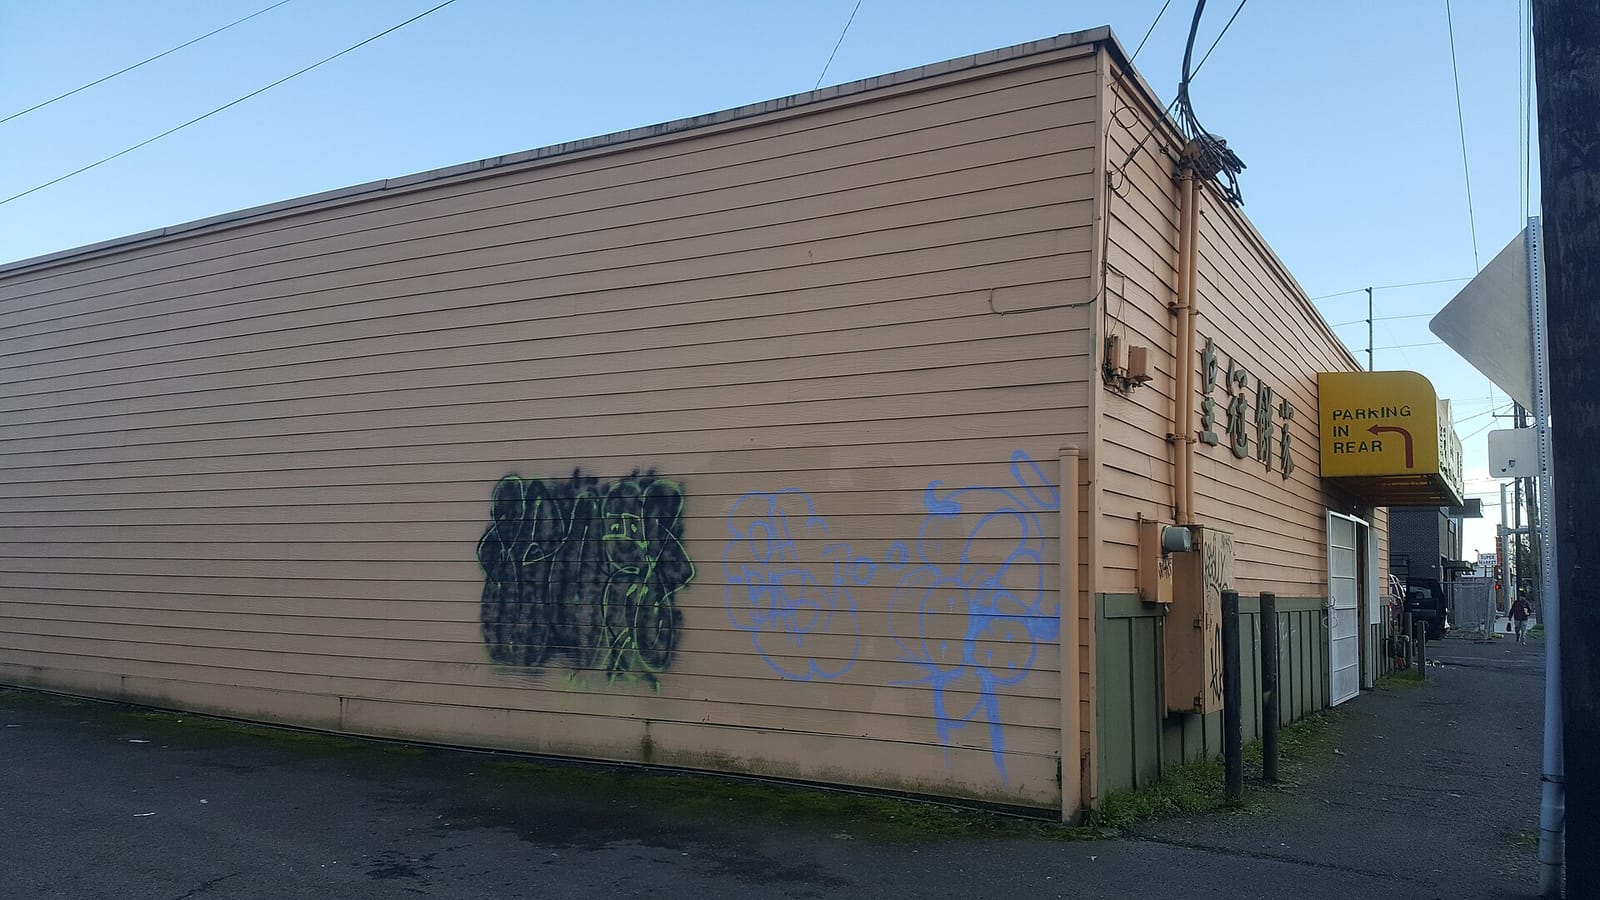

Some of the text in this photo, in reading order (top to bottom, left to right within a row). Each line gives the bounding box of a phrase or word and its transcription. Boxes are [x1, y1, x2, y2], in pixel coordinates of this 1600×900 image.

[1333, 405, 1411, 421] PARKING
[1333, 425, 1348, 438] IN
[1334, 440, 1382, 454] REAR
